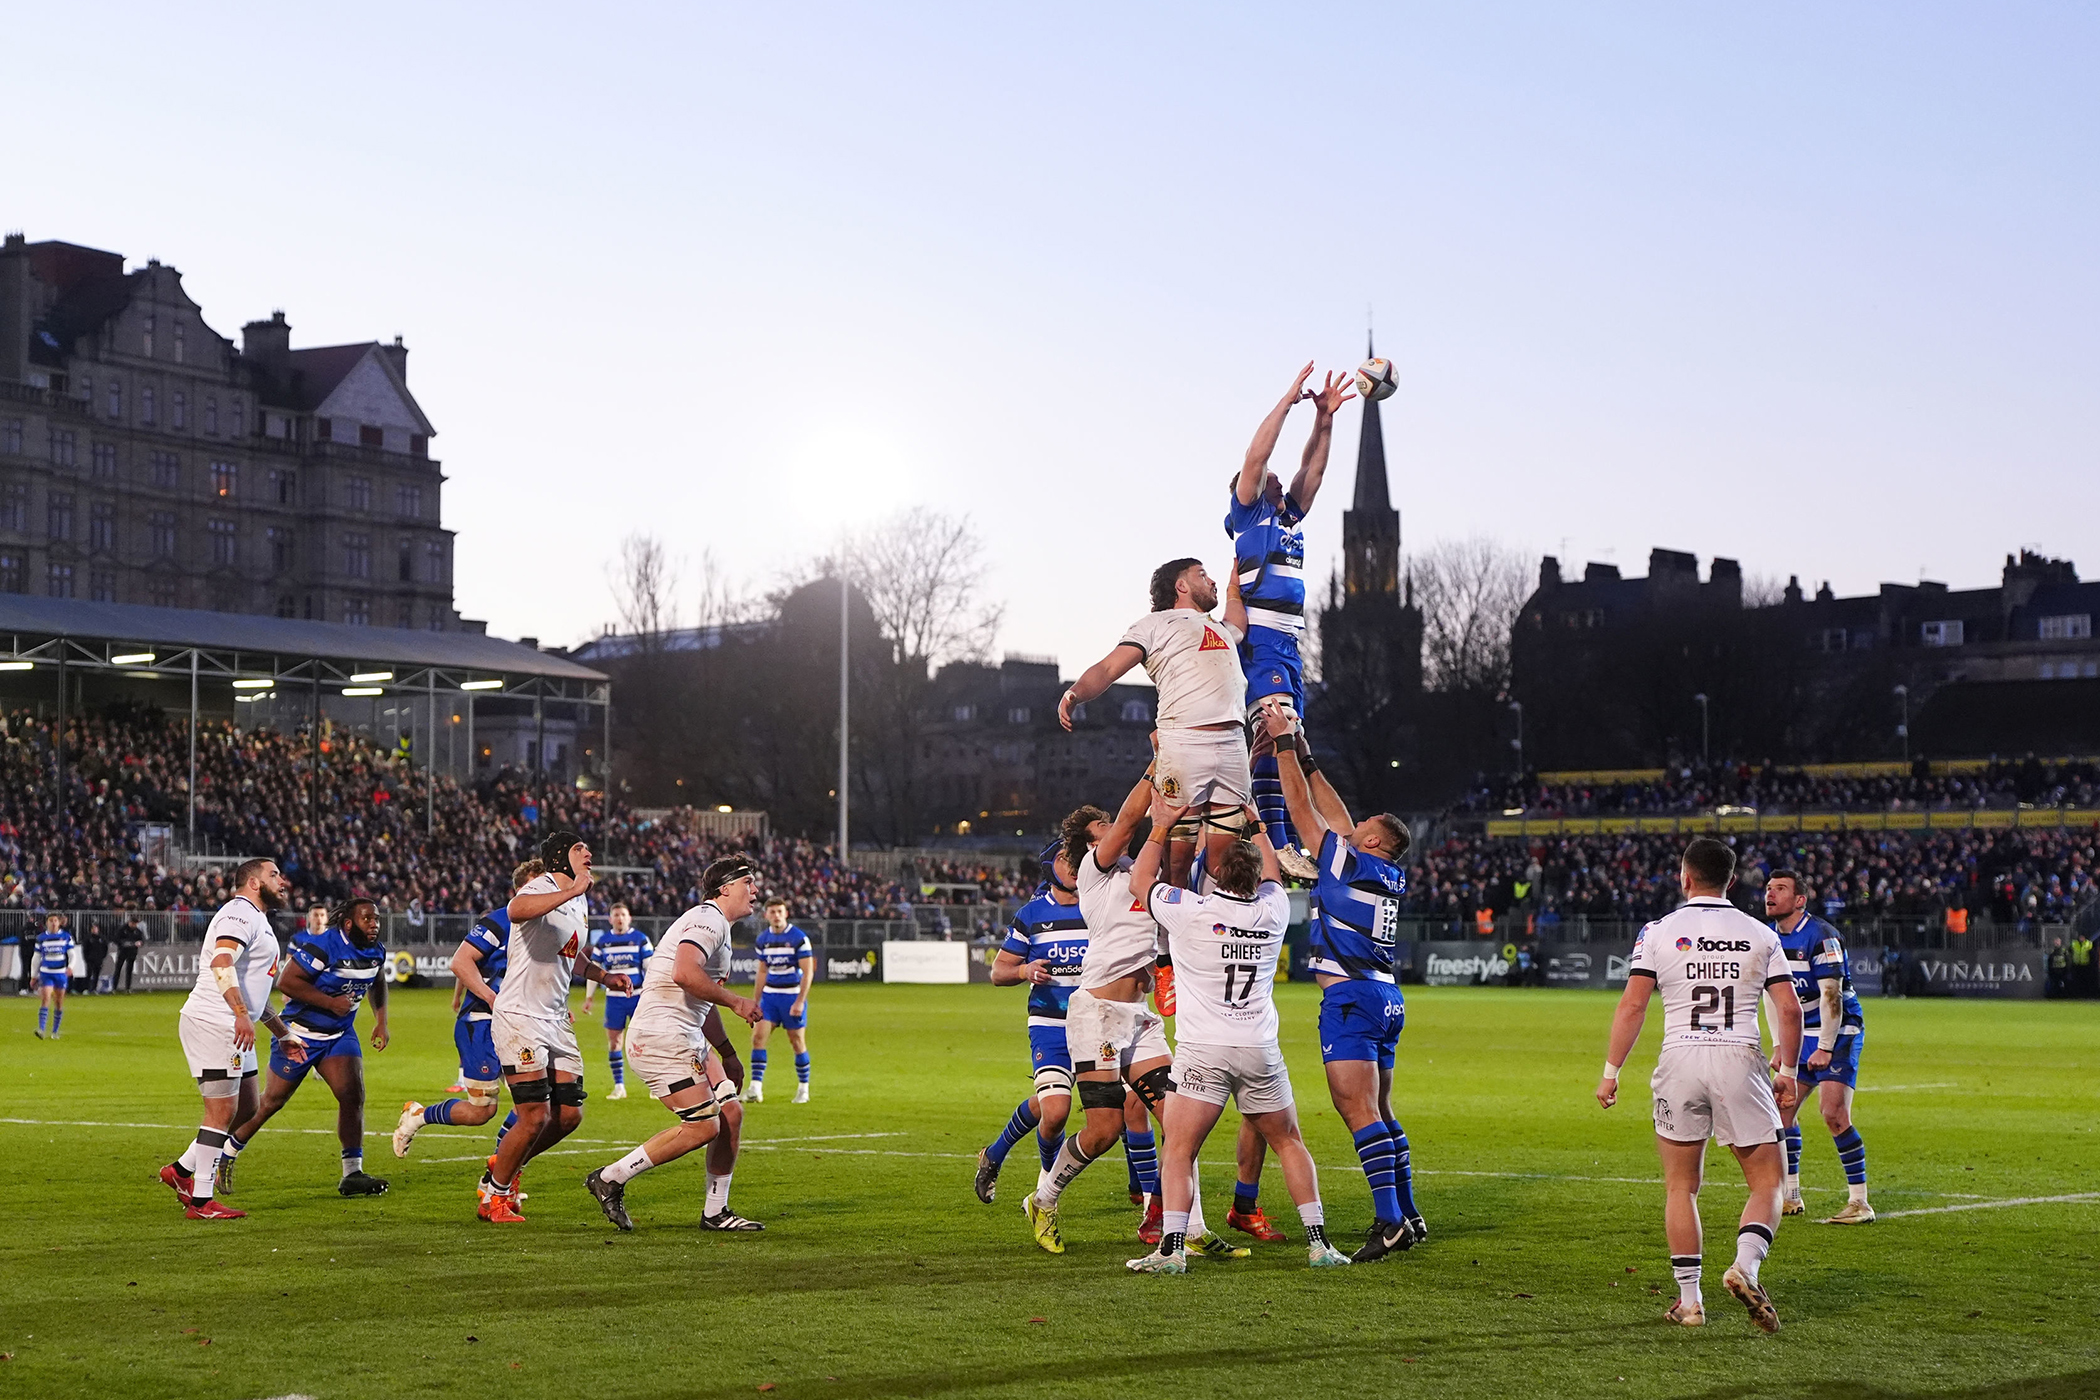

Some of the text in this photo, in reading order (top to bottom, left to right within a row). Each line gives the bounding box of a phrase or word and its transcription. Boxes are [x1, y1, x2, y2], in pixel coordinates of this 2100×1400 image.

[1203, 631, 1225, 648] Sika
[1230, 926, 1270, 939] focus
[1221, 944, 1262, 960] CHIEFS
[1697, 937, 1751, 951] focus
[828, 957, 873, 979] freestyle
[1427, 953, 1509, 983] freestyle
[1686, 962, 1740, 980] CHIEFS
[1920, 960, 2033, 982] VIÑALBA
[1224, 963, 1258, 1003] 17
[1691, 986, 1734, 1031] 21
